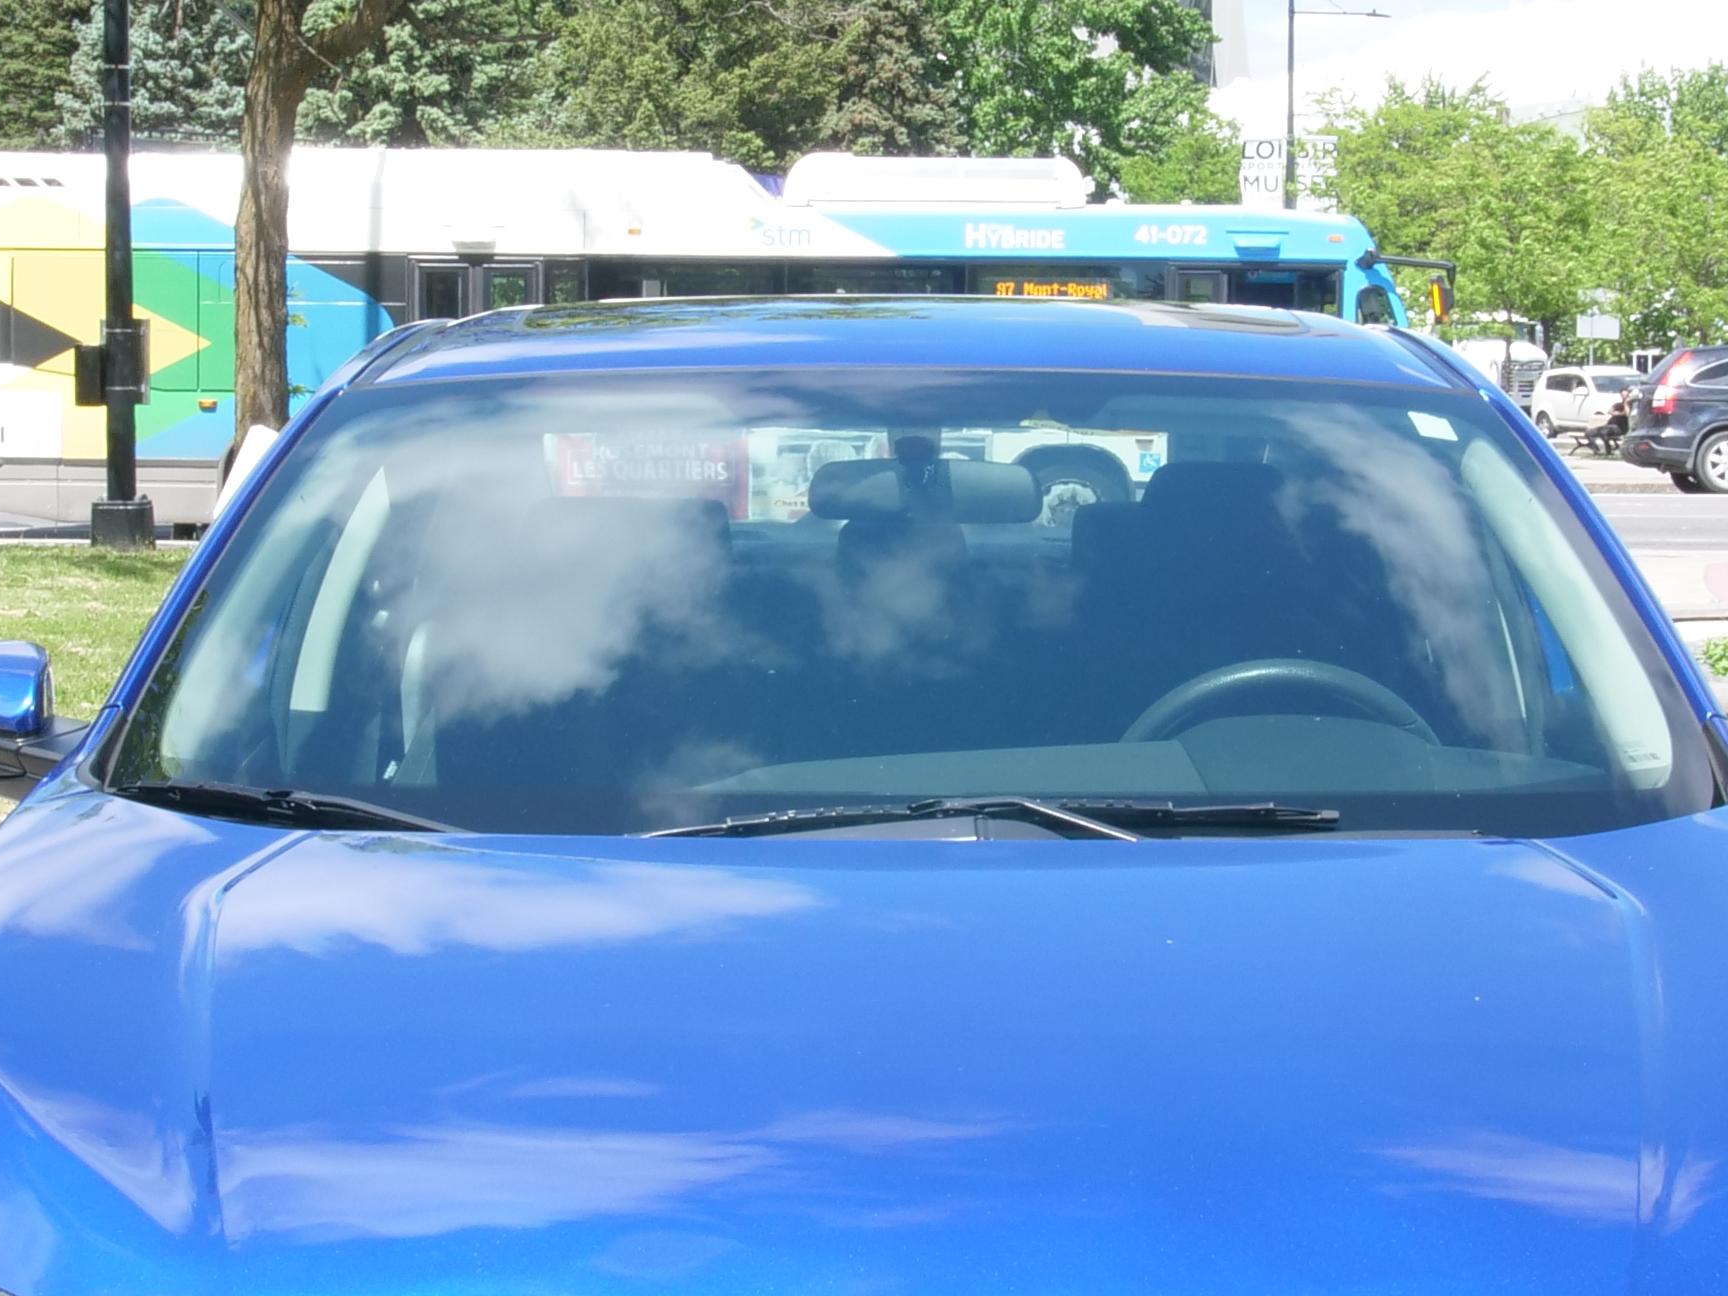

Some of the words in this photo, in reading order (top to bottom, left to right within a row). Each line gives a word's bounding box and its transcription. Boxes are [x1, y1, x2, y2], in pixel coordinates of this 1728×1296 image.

[762, 225, 812, 247] stm
[965, 223, 1065, 249] HYBRIDE
[1134, 224, 1208, 246] 41-072
[995, 281, 1015, 297] 97
[1023, 280, 1109, 300] Mont-Royal
[572, 460, 606, 480] LES
[613, 460, 729, 480] QUARTIERS
